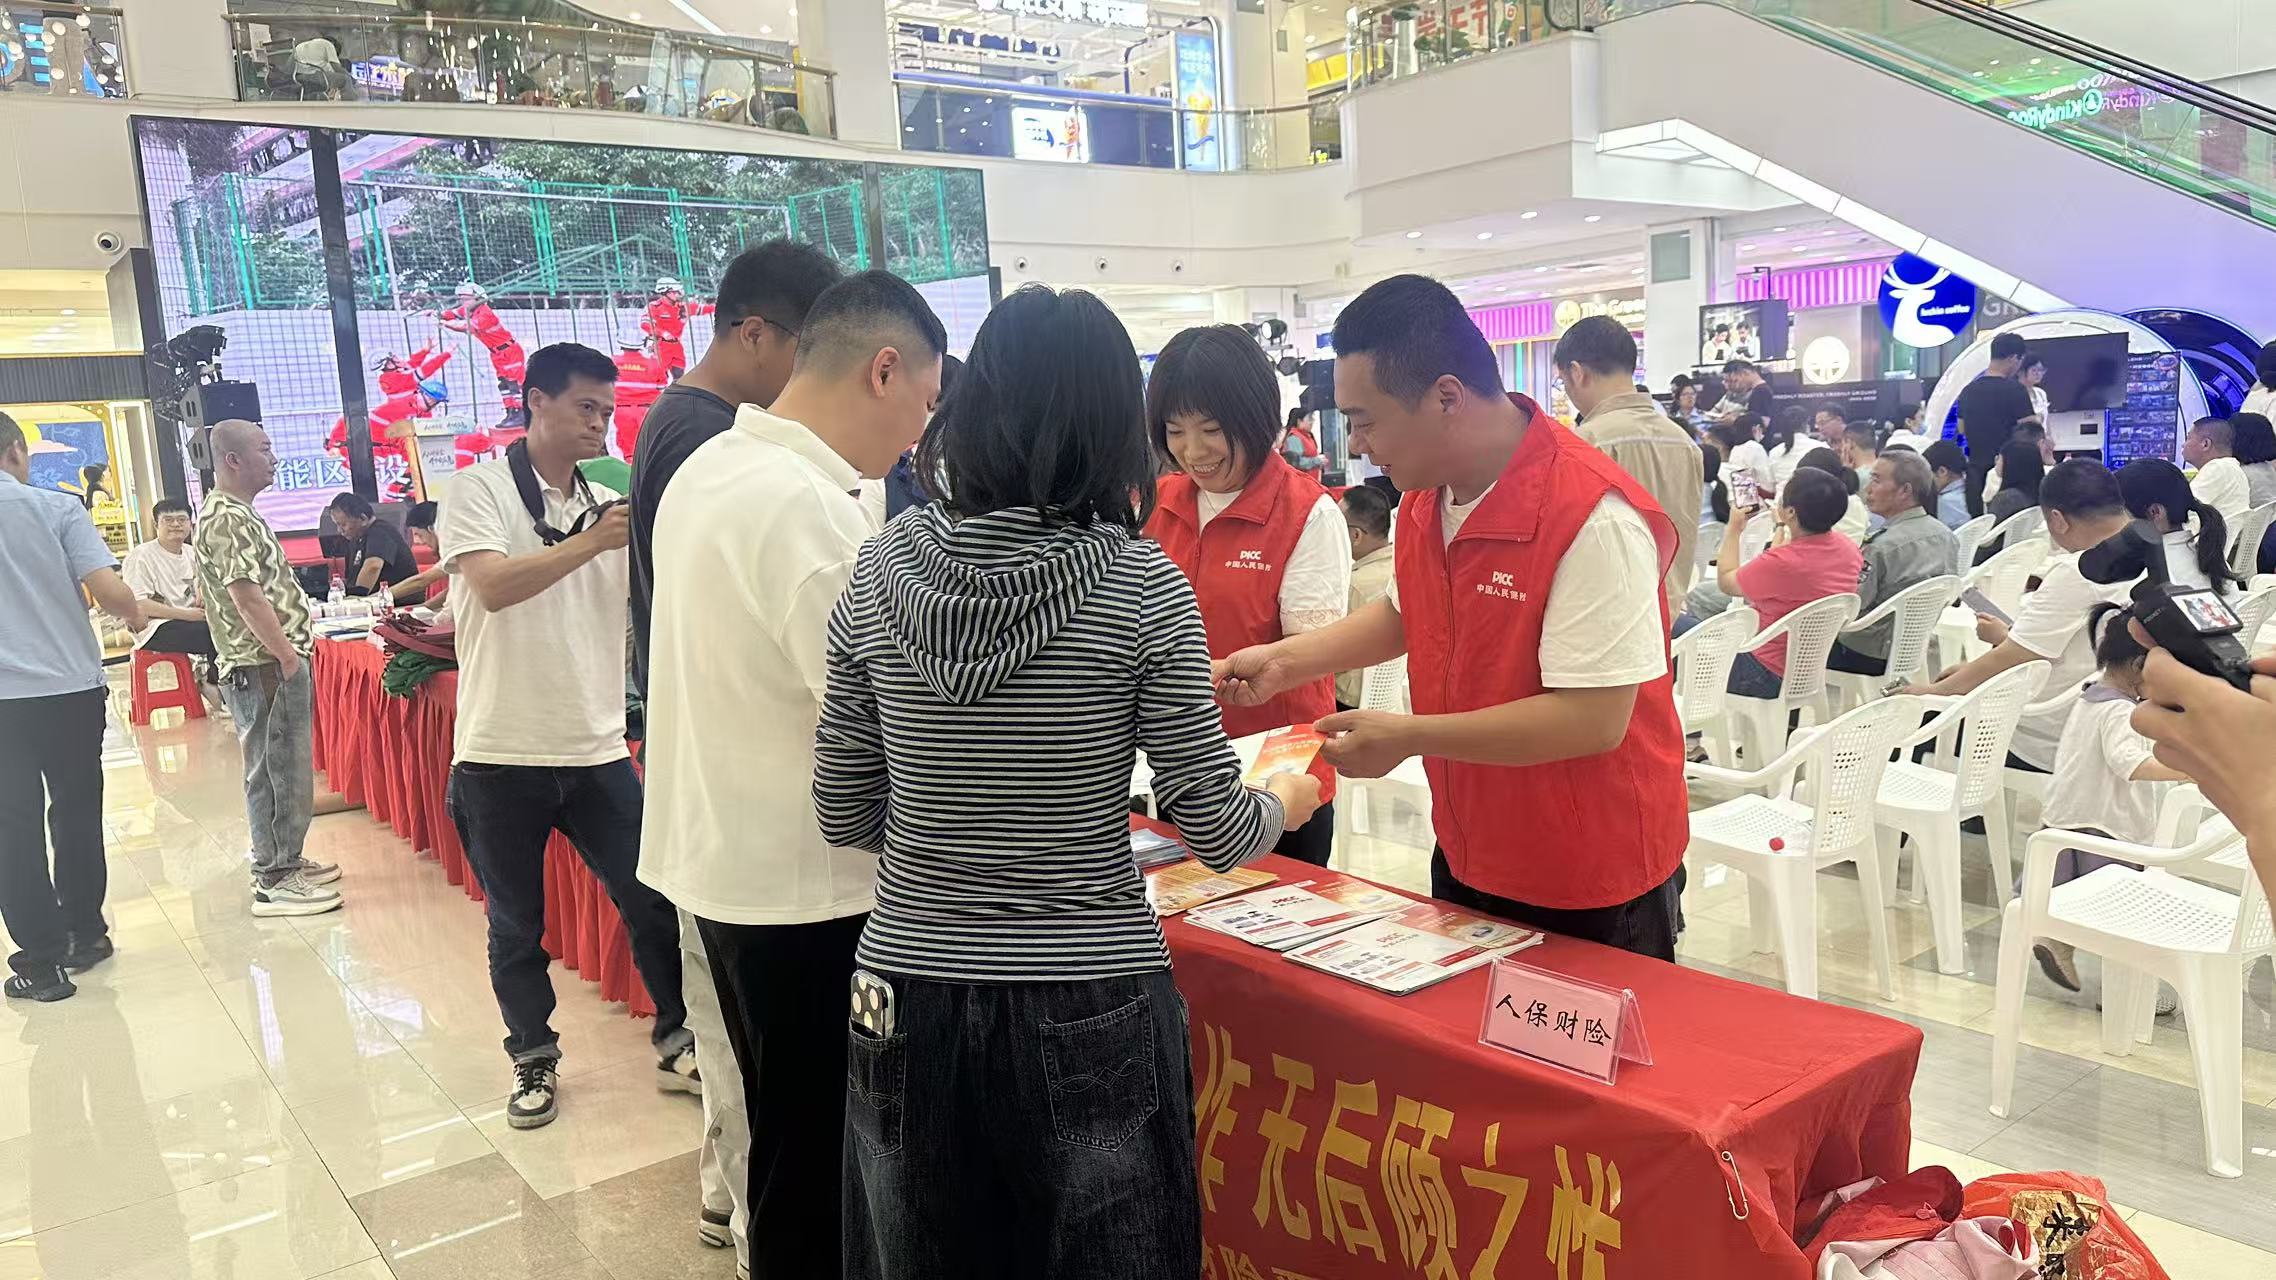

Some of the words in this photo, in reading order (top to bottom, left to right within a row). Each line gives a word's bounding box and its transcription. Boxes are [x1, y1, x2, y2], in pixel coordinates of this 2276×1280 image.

[1240, 550, 1262, 560] PICC
[1492, 570, 1514, 587] PICC
[1496, 994, 1612, 1046] 人保财险
